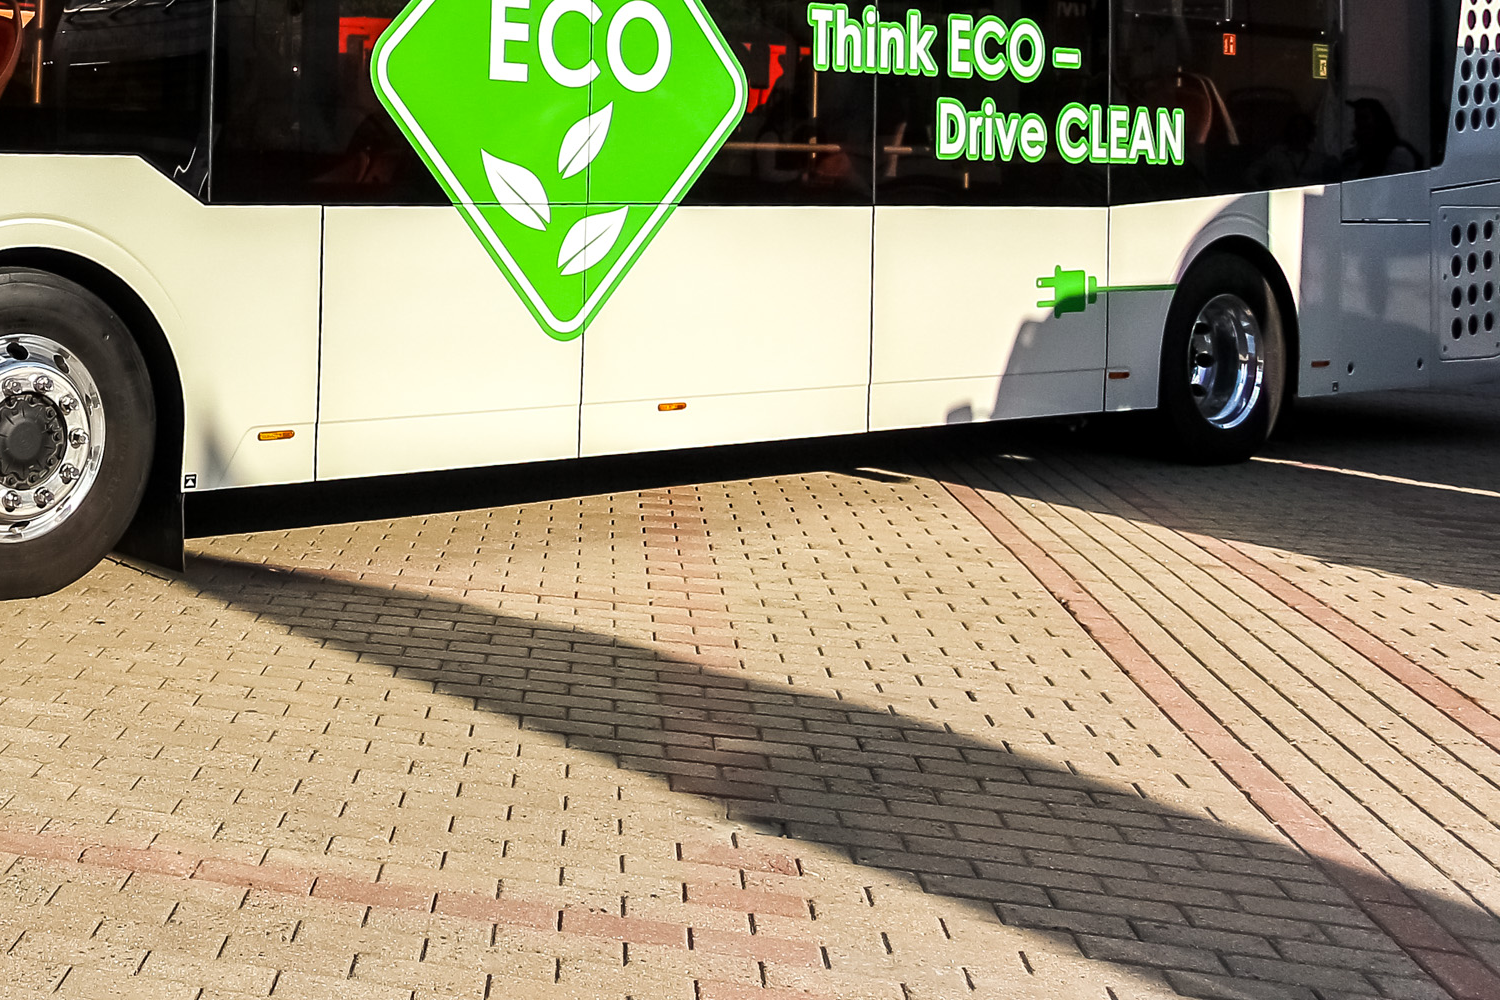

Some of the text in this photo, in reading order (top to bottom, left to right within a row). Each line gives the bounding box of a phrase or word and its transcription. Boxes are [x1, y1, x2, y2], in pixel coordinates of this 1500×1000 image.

[808, 4, 937, 75] Think
[948, 15, 1045, 82] ECO
[937, 98, 1184, 164] Drive CLEAN
